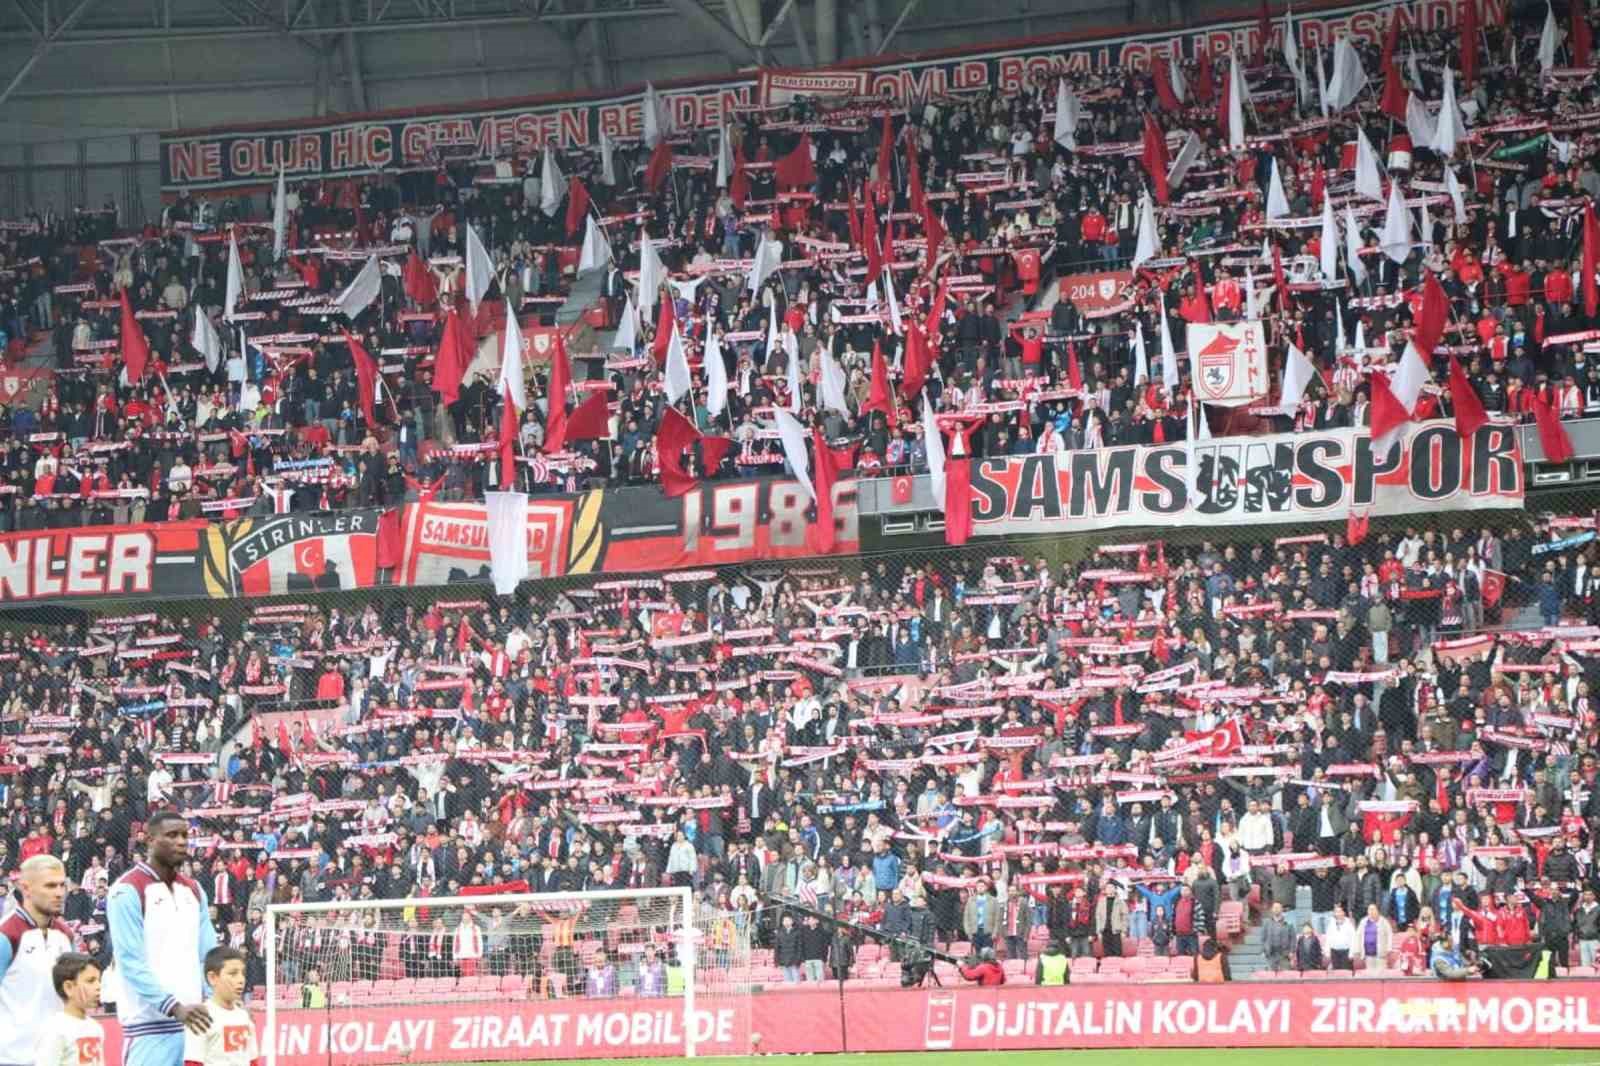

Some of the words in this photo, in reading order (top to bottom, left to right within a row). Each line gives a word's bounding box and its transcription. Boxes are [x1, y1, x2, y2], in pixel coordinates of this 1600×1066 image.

[170, 142, 222, 182] NE
[229, 133, 322, 176] OLUR
[1071, 284, 1095, 300] 204
[970, 424, 1523, 522] SAMSUNSPOR
[1151, 999, 1291, 1034] KOLAYI
[319, 1018, 437, 1054] KOLAYI
